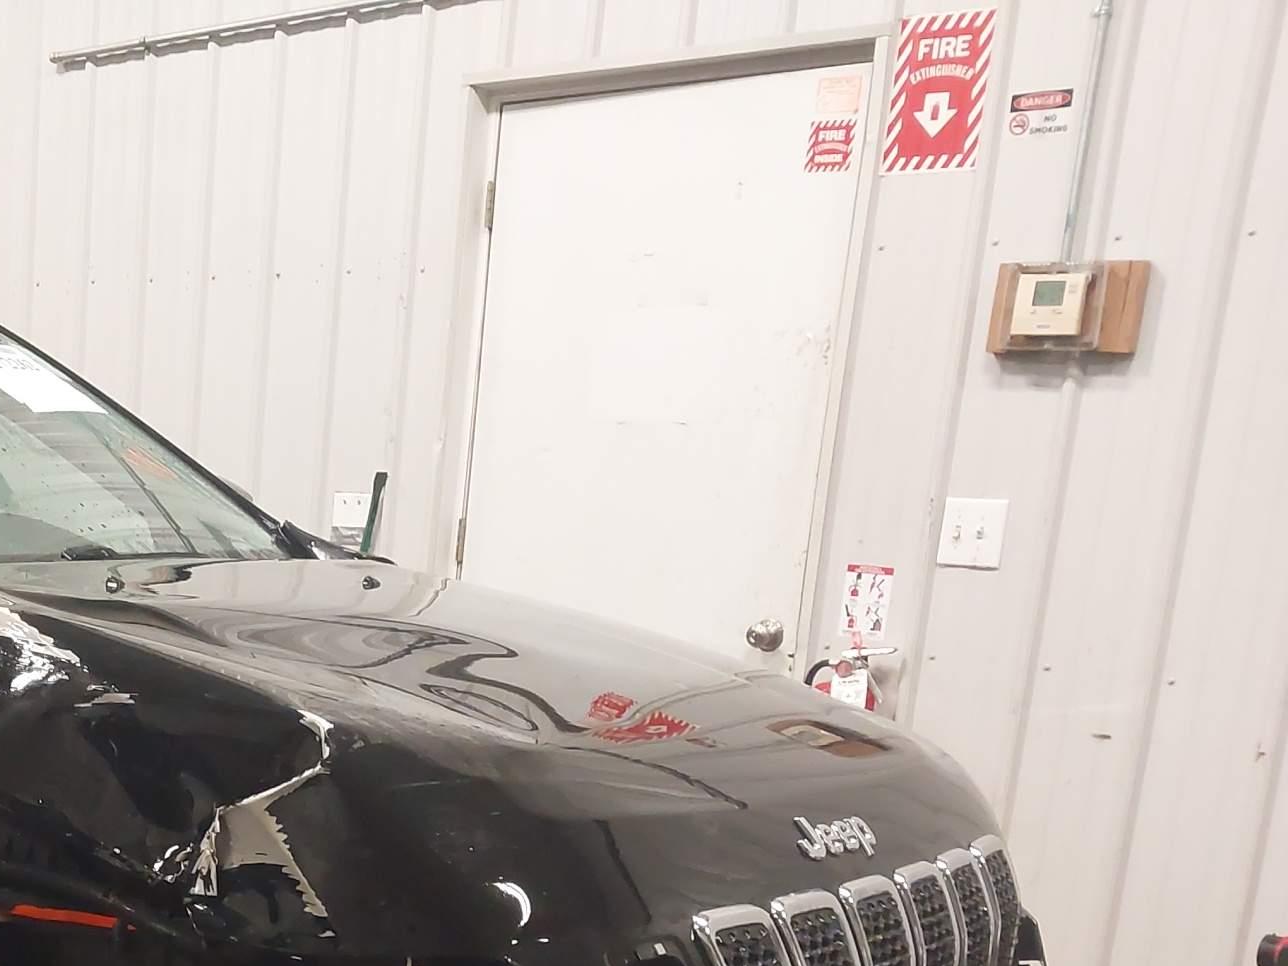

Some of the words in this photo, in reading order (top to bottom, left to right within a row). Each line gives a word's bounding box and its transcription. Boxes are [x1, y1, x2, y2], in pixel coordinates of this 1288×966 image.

[917, 34, 973, 62] FIRE
[1043, 114, 1057, 122] NO
[818, 129, 846, 142] FIRE
[793, 815, 877, 861] Jeep
